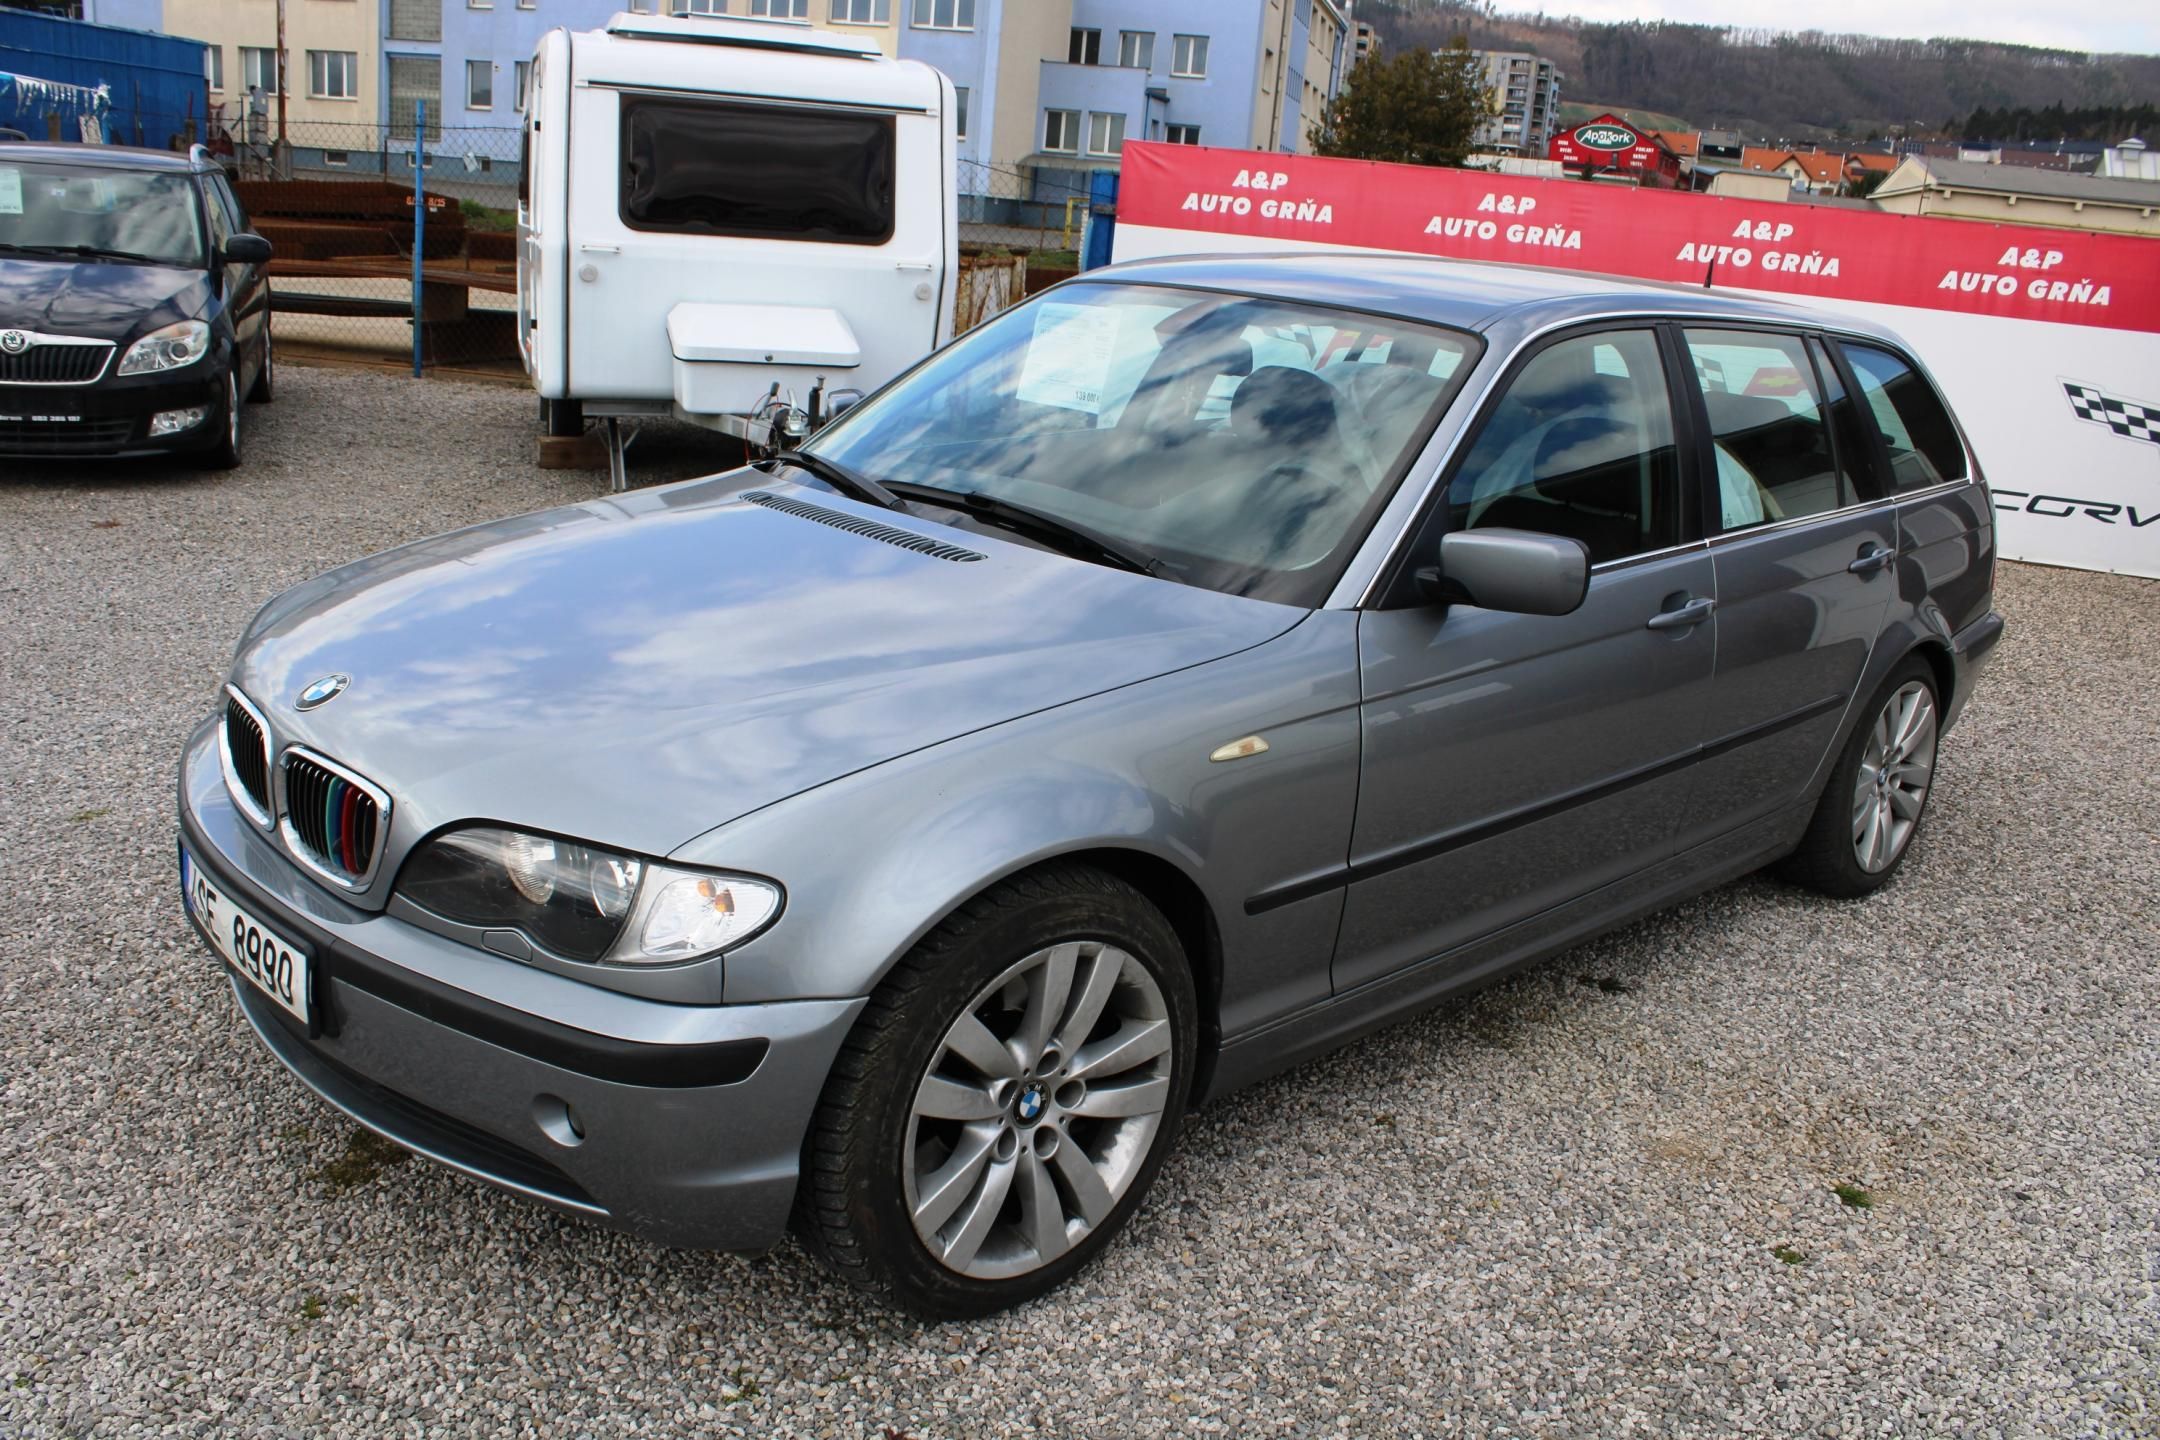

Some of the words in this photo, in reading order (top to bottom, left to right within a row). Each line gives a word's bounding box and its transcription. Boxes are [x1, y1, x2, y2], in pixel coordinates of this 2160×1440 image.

[1232, 169, 1289, 191] A&P
[1181, 192, 1252, 215] AUTO
[1260, 198, 1333, 224] GRŇA
[1477, 193, 1537, 215] A&P
[1424, 215, 1497, 240] AUTO
[1506, 223, 1581, 249] GRŇA
[1732, 219, 1794, 242] A&P
[1676, 242, 1752, 267] AUTO
[1761, 250, 1840, 277] GRŇA
[1997, 246, 2064, 270] A&P
[1937, 270, 2018, 296] AUTO
[2027, 278, 2111, 306] GRŇA
[232, 913, 294, 1005] 8990
